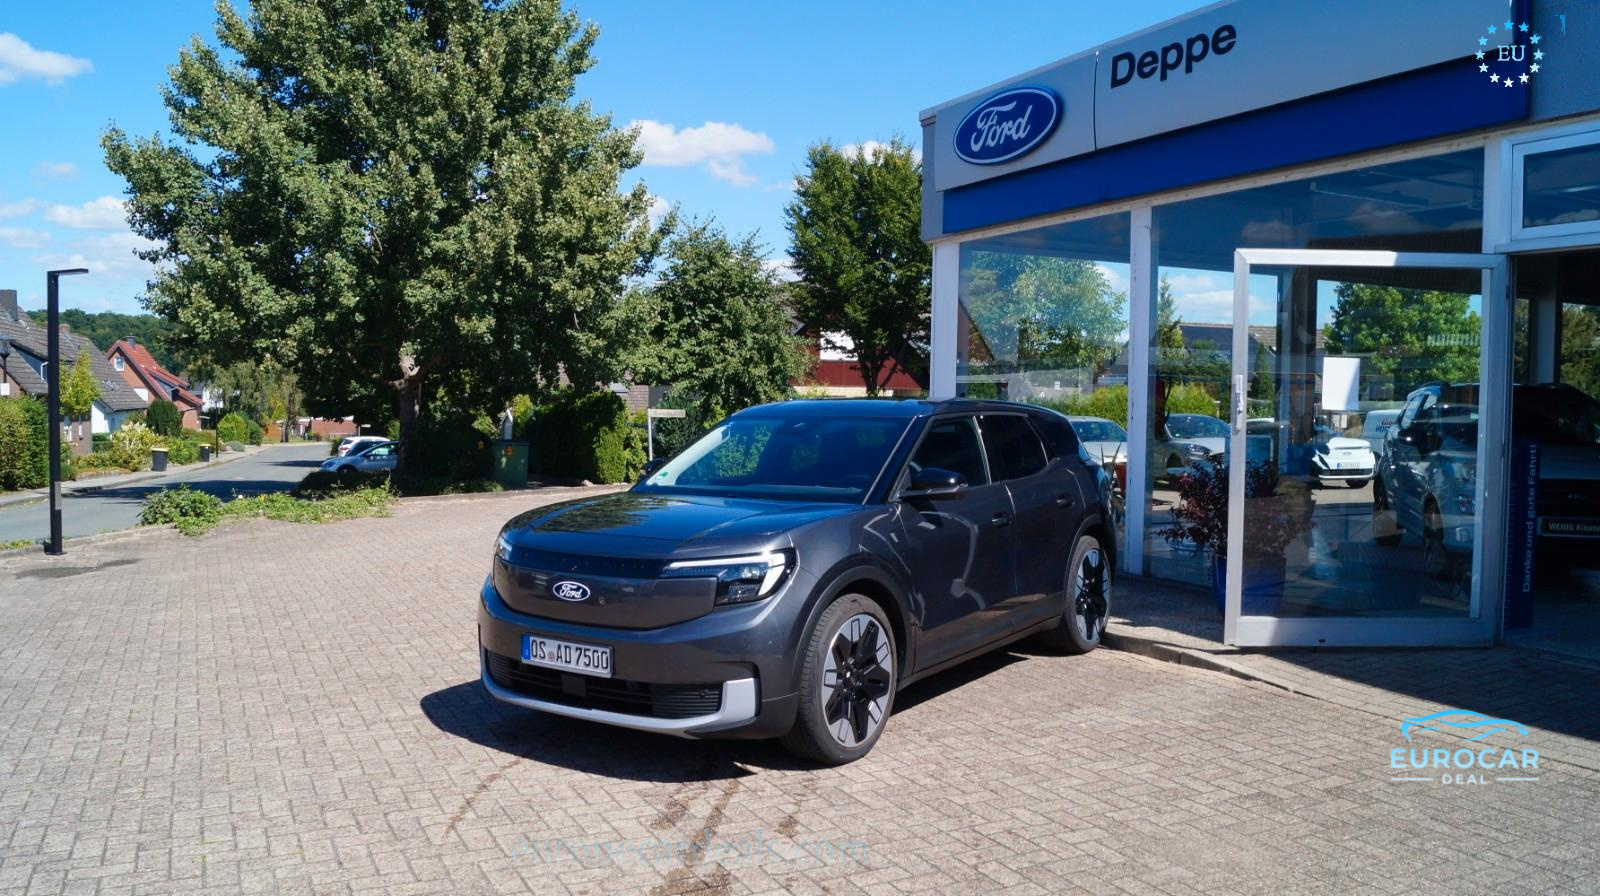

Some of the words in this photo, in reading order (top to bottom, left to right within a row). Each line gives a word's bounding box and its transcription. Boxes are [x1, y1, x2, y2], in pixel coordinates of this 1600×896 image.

[1110, 23, 1237, 88] Deppe
[970, 99, 1031, 153] Ford
[1527, 487, 1536, 519] gute
[1525, 521, 1534, 547] und
[559, 583, 583, 598] Ford
[531, 639, 546, 659] OS
[556, 644, 572, 664] AD
[575, 647, 609, 669] 7500
